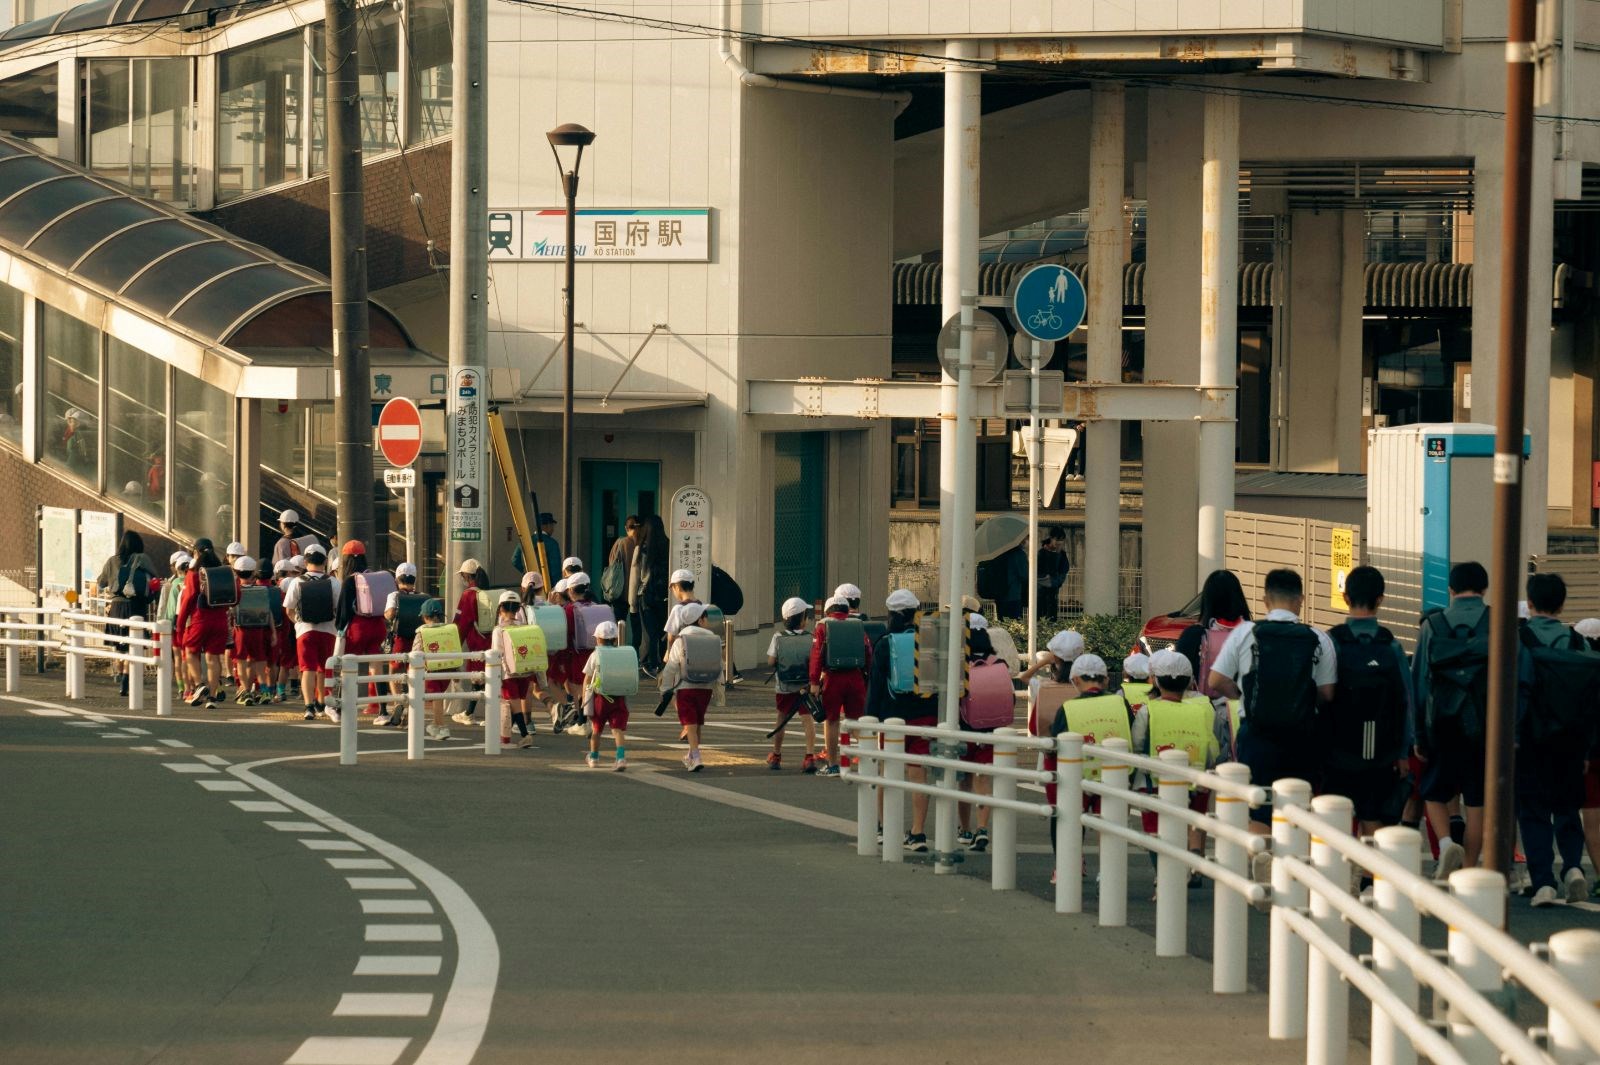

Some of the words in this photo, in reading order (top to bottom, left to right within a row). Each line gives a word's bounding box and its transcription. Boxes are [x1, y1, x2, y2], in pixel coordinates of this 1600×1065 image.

[594, 219, 682, 247] 国府駅
[531, 237, 587, 256] MEITESU
[605, 248, 636, 256] STATION
[374, 373, 447, 395] 東口
[457, 406, 467, 479] みまもりポール
[680, 520, 705, 529] のりば
